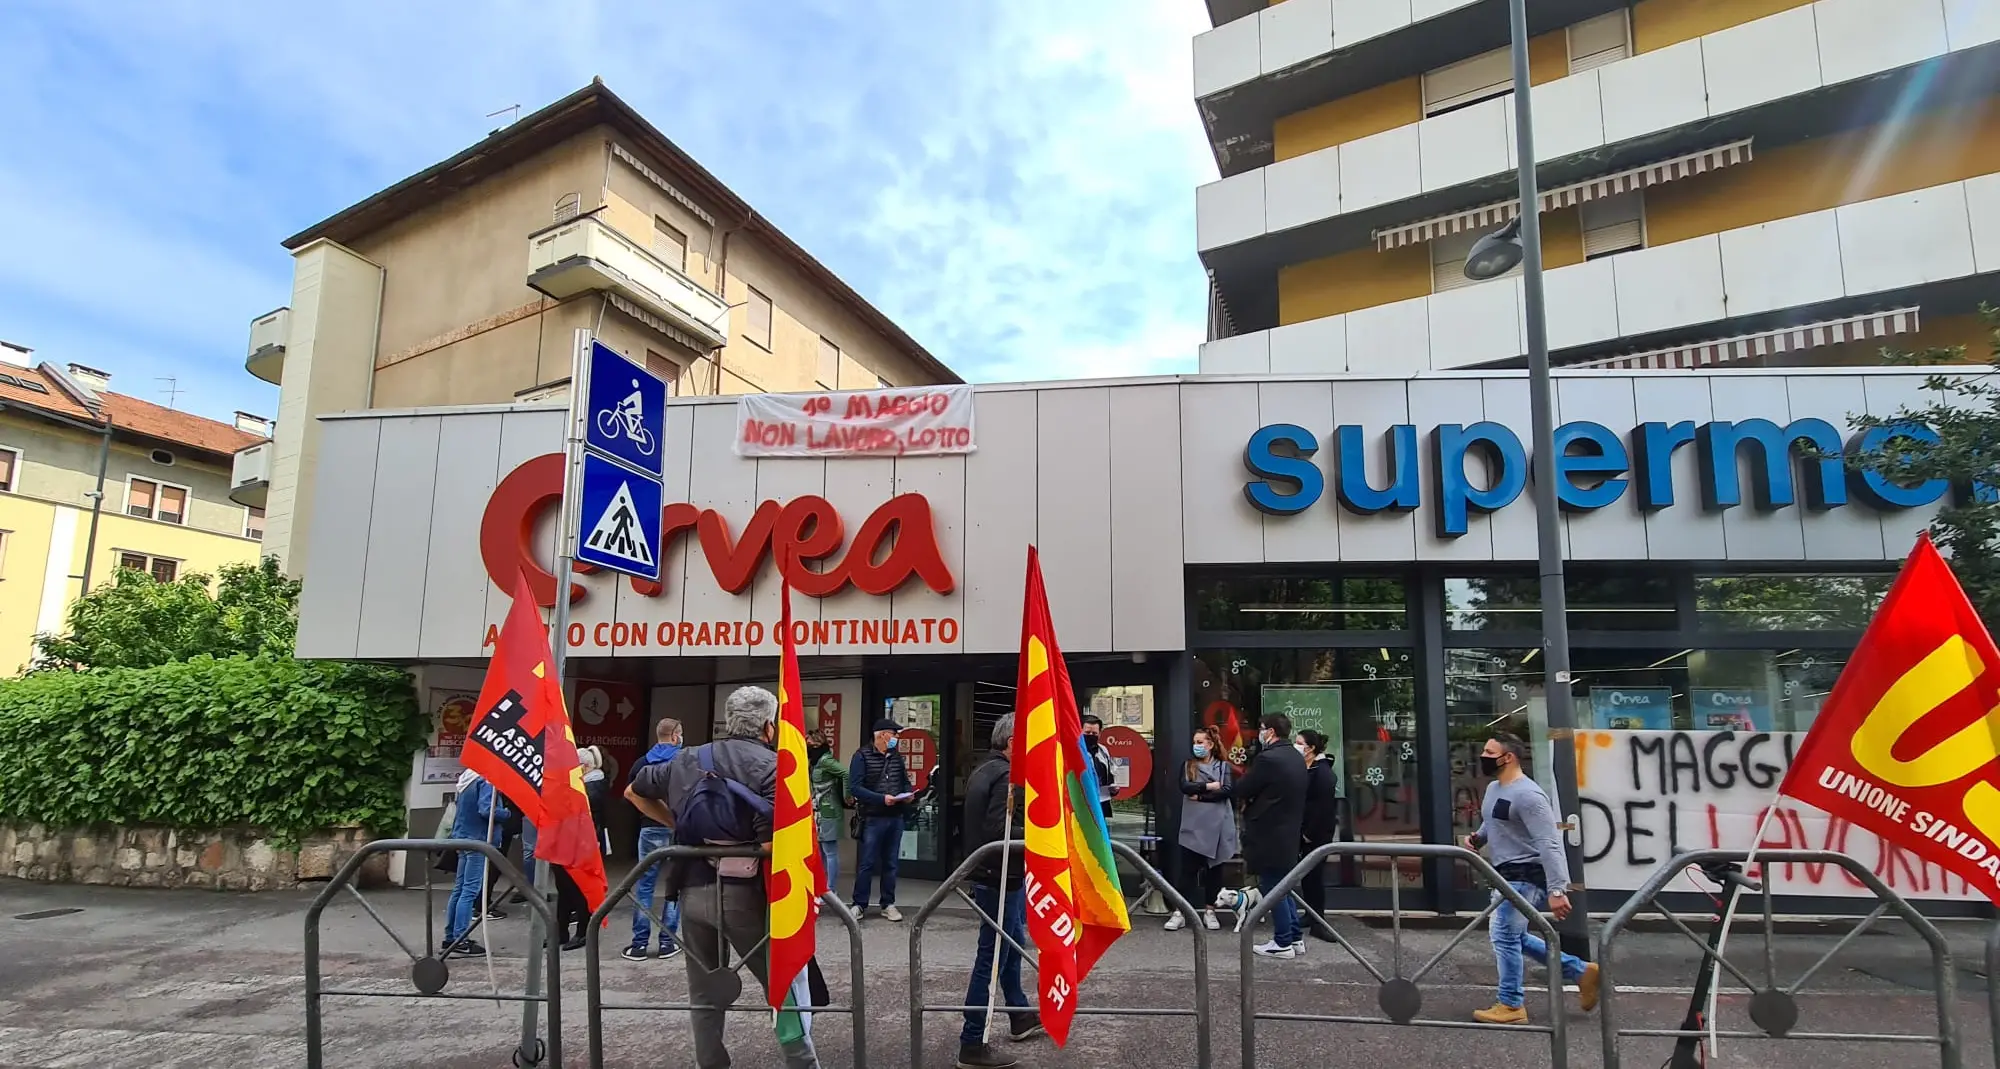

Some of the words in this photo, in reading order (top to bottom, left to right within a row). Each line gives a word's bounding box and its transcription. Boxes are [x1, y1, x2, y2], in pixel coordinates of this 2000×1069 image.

[843, 393, 949, 419] MAGGIO
[744, 418, 796, 447] NON
[908, 426, 970, 448] LOTTO
[593, 622, 648, 647] CON
[656, 621, 764, 647] ORARIO
[772, 618, 959, 646] CONTINUATO
[1283, 701, 1322, 718] REGINA
[1610, 691, 1651, 705] Orvea
[1292, 717, 1324, 729] LICK
[502, 727, 545, 774] ASSO
[1629, 732, 1794, 796] MAGGI
[1818, 765, 1911, 824] UNIONE
